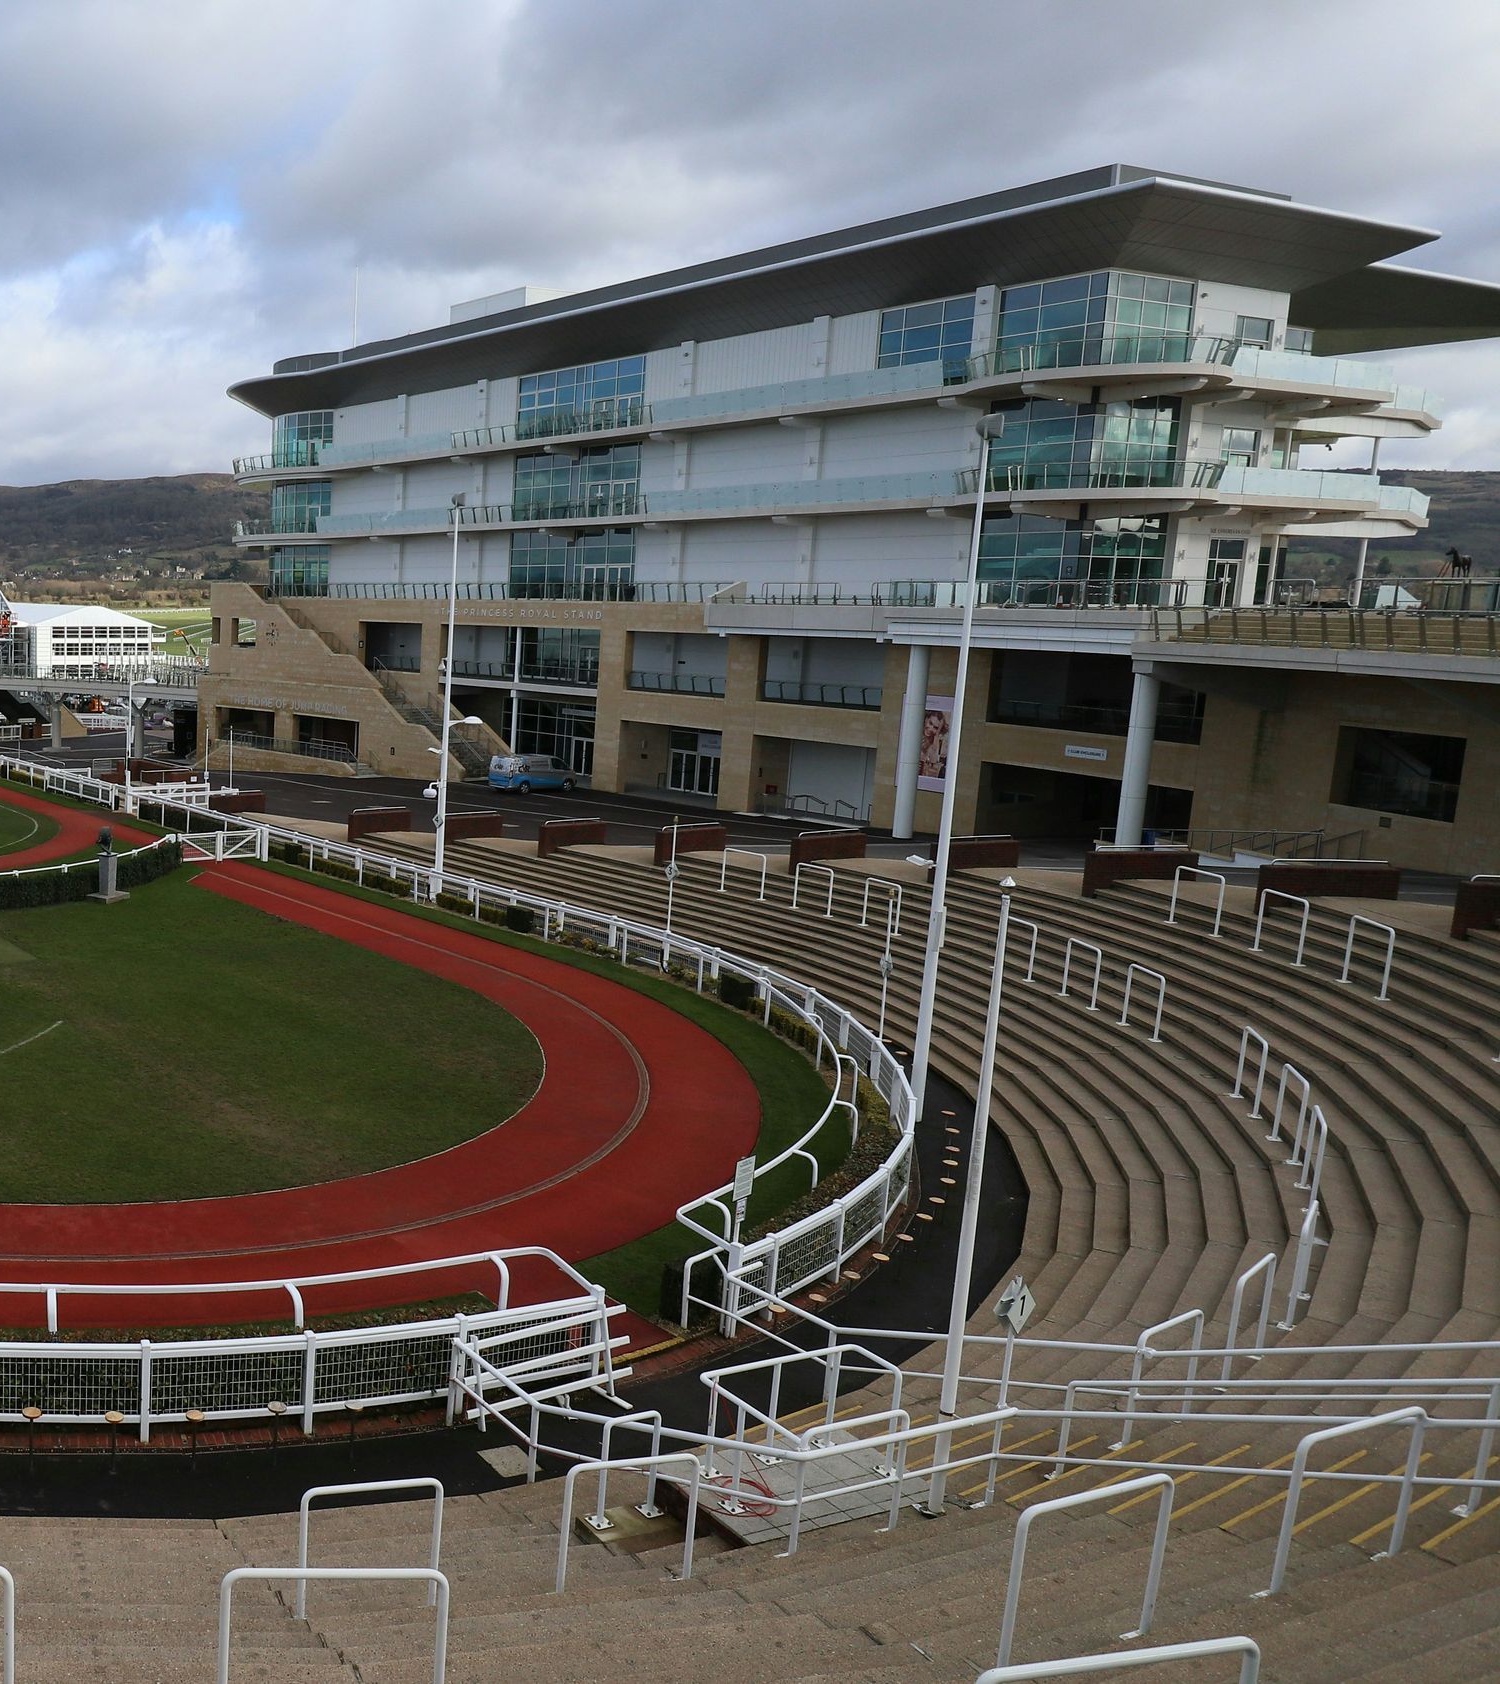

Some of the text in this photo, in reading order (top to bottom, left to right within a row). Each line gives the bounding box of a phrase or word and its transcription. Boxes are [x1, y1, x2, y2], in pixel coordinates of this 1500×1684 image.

[463, 607, 514, 618] PRINCESS
[519, 609, 557, 619] ROYAL
[563, 609, 602, 621] STAND
[247, 697, 273, 708] HOME
[275, 699, 287, 709] OF
[667, 866, 673, 876] 3
[1019, 1294, 1027, 1317] 1
